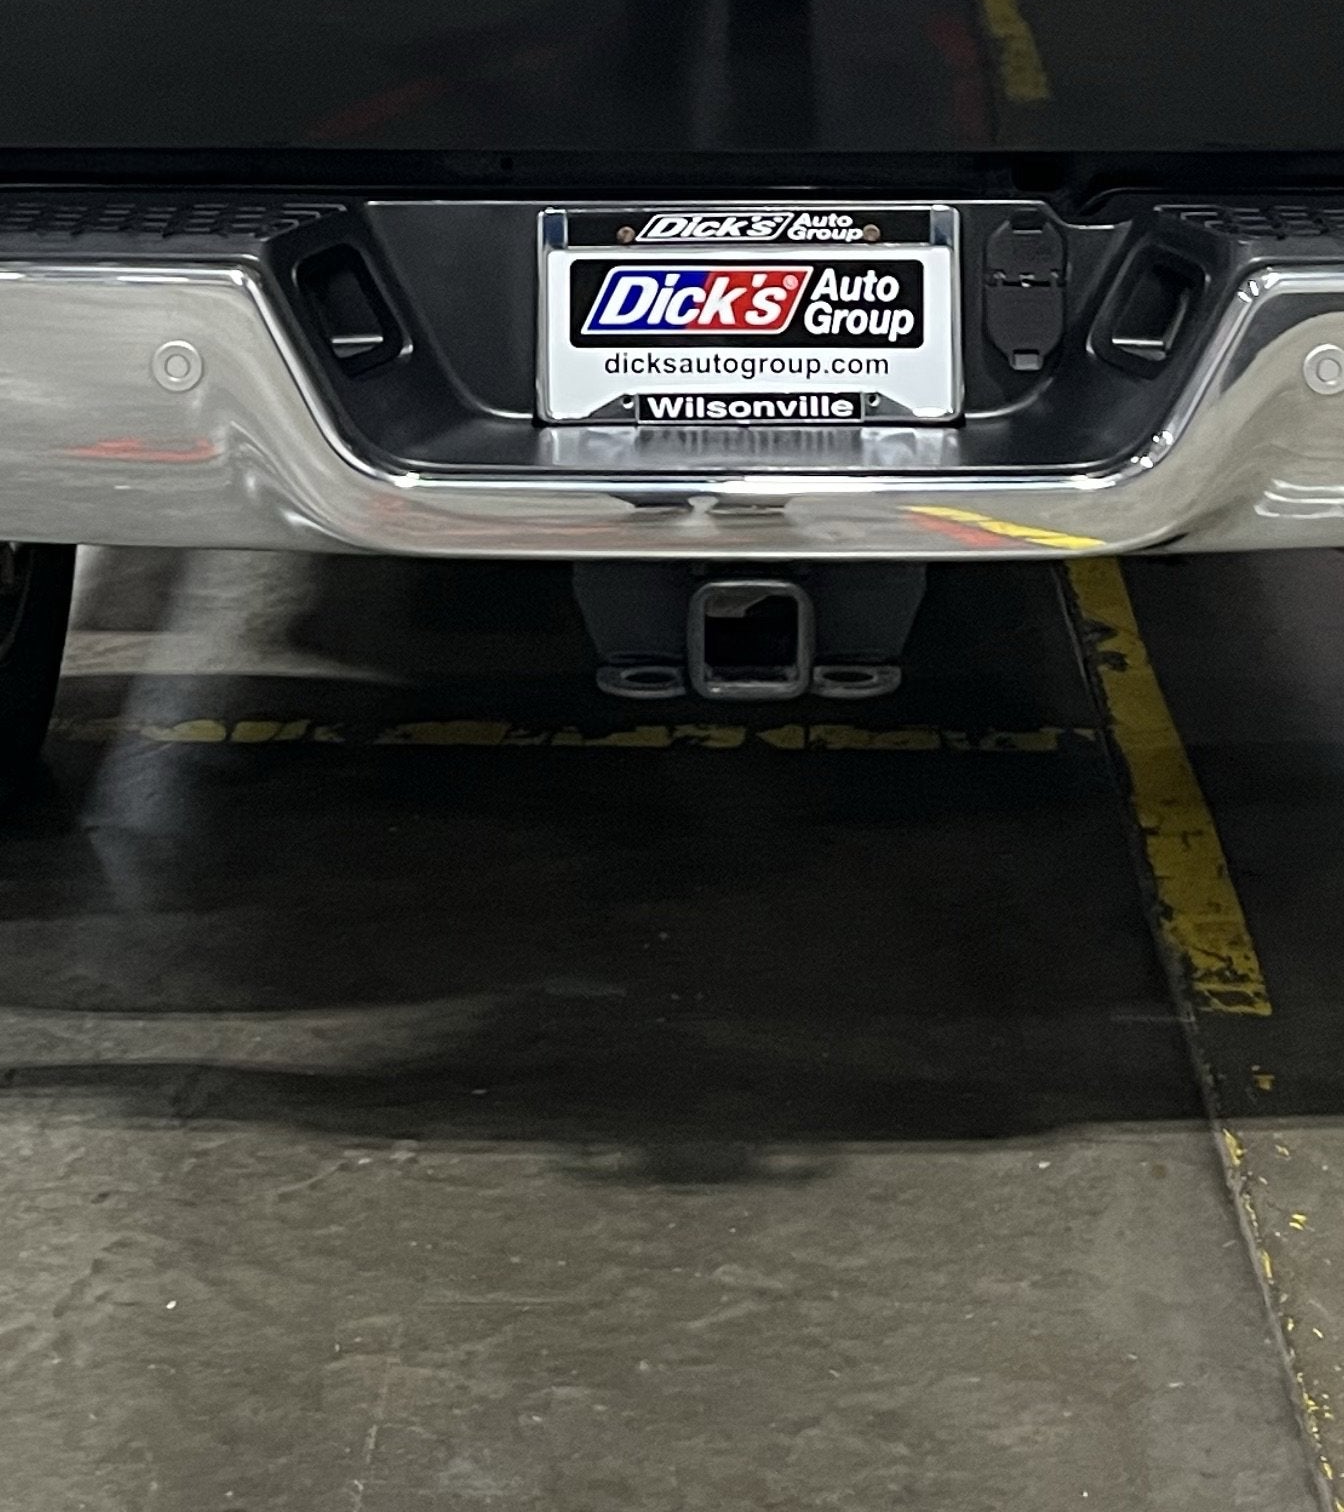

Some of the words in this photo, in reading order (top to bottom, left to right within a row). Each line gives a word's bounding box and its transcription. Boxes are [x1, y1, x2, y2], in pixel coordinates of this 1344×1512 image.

[650, 214, 784, 239] Dick's
[798, 213, 853, 228] Auto
[788, 224, 864, 242] Group
[598, 273, 787, 326] Dick's
[811, 268, 899, 302] Auto
[804, 302, 915, 341] Group
[604, 353, 889, 379] dicksautogroup.com
[647, 396, 854, 418] Wilsonville
